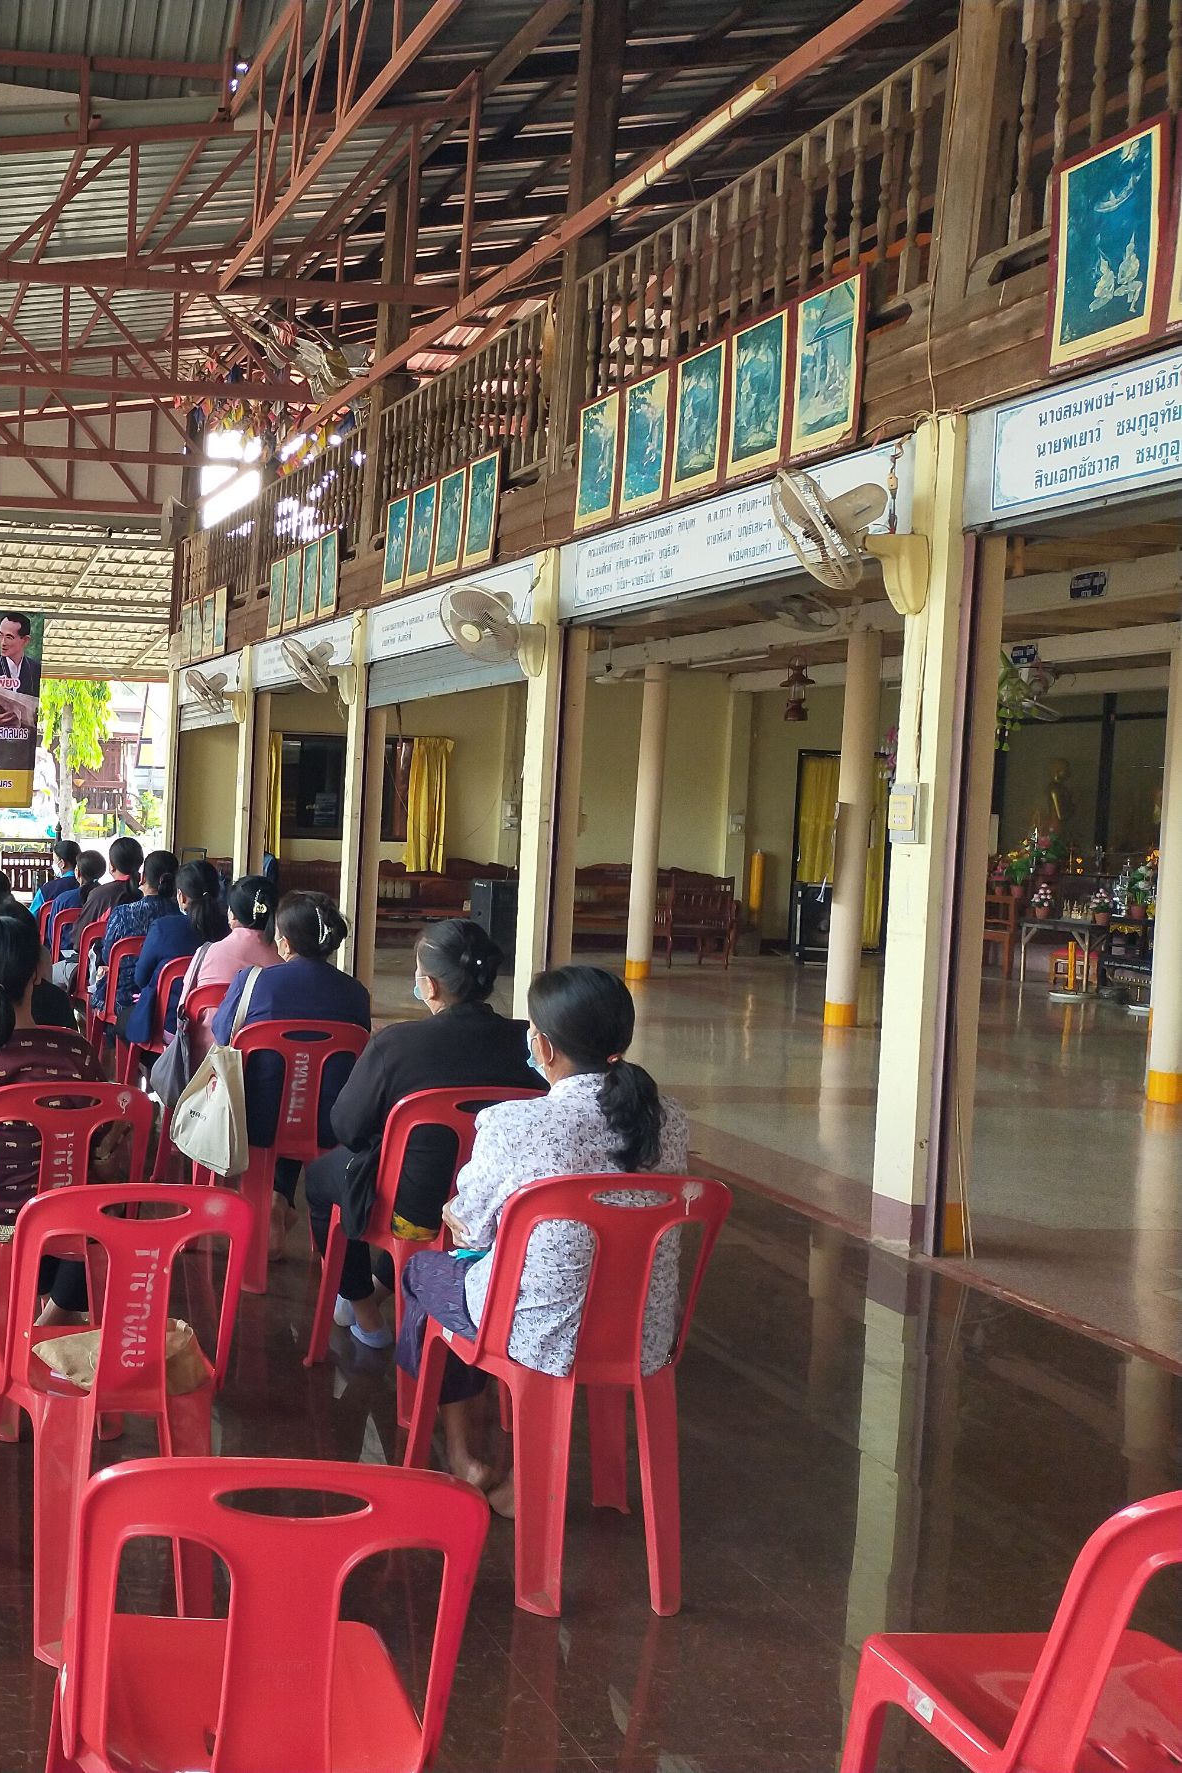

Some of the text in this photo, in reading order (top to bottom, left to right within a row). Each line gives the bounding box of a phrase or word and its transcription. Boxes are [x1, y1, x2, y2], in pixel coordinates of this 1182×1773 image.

[1038, 363, 1182, 427] นางสมพงษ์-นายนิภั
